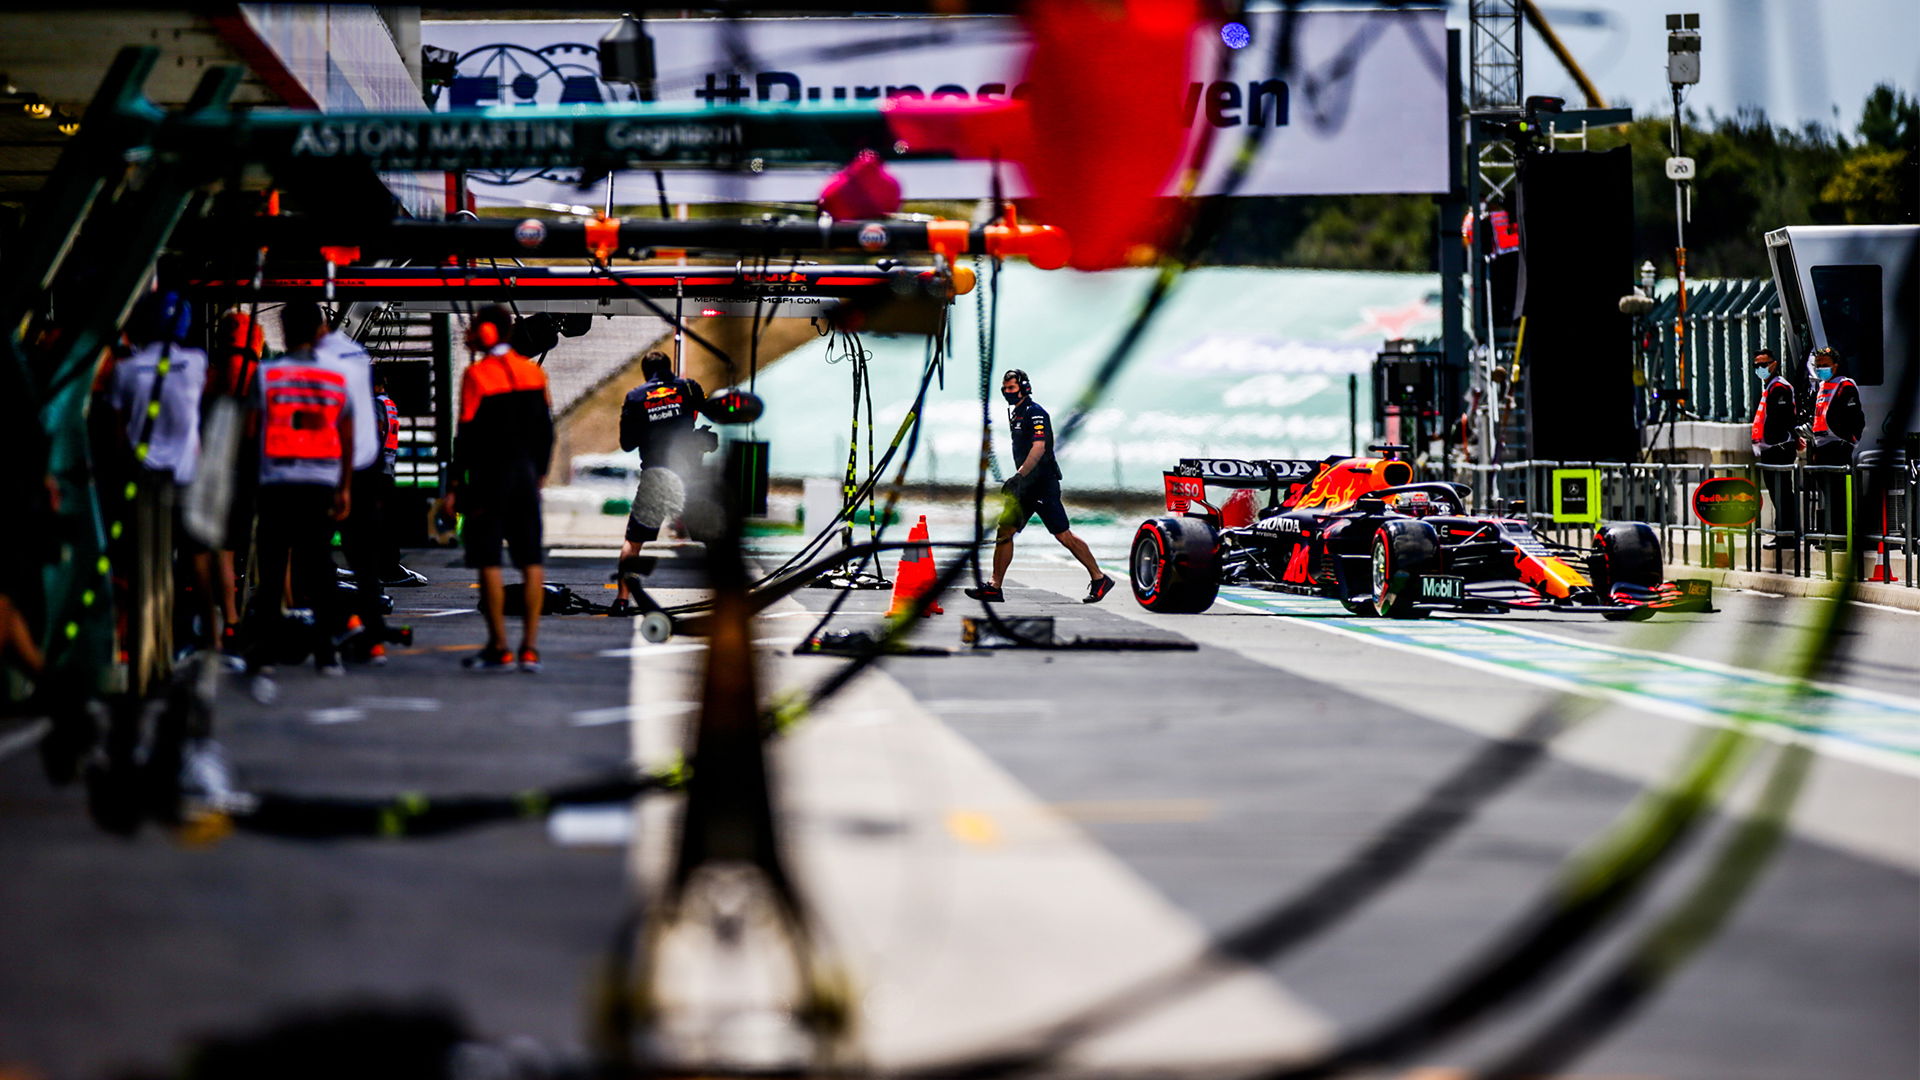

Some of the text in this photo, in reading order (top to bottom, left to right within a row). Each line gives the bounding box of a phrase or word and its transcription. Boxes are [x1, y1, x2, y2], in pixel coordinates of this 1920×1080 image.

[293, 119, 573, 156] ASTON MARTIN
[649, 410, 673, 421] Mobil
[1172, 483, 1199, 497] ESSO
[1257, 517, 1300, 533] HONDA
[1422, 578, 1452, 597] Mobil
